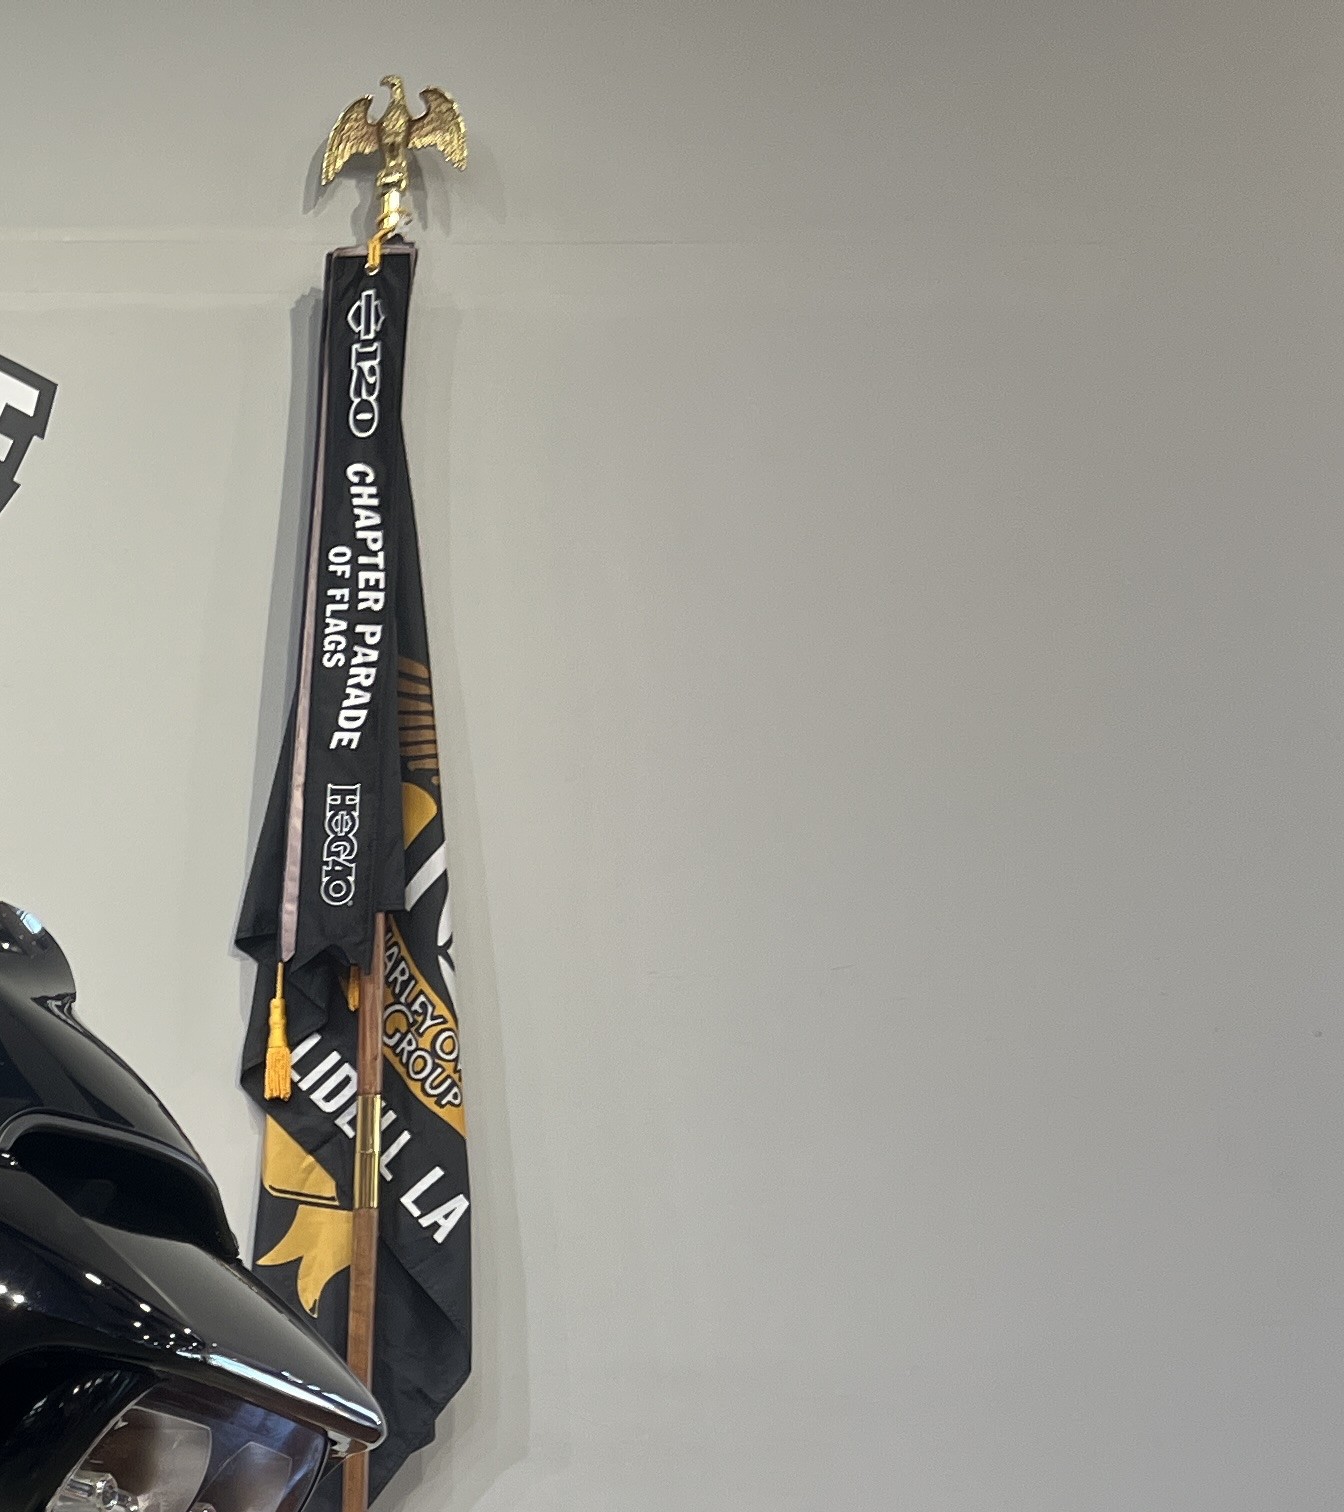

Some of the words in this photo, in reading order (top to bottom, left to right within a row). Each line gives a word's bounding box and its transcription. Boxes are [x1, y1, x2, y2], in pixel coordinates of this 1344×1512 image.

[349, 340, 382, 438] 120
[327, 545, 352, 579] OF
[345, 462, 386, 612] CHAPTER
[322, 587, 350, 669] FLAGS
[329, 623, 383, 750] PARADE
[384, 933, 447, 1034] ARLEY
[382, 1003, 461, 1106] GROUP
[399, 1165, 470, 1244] LA
